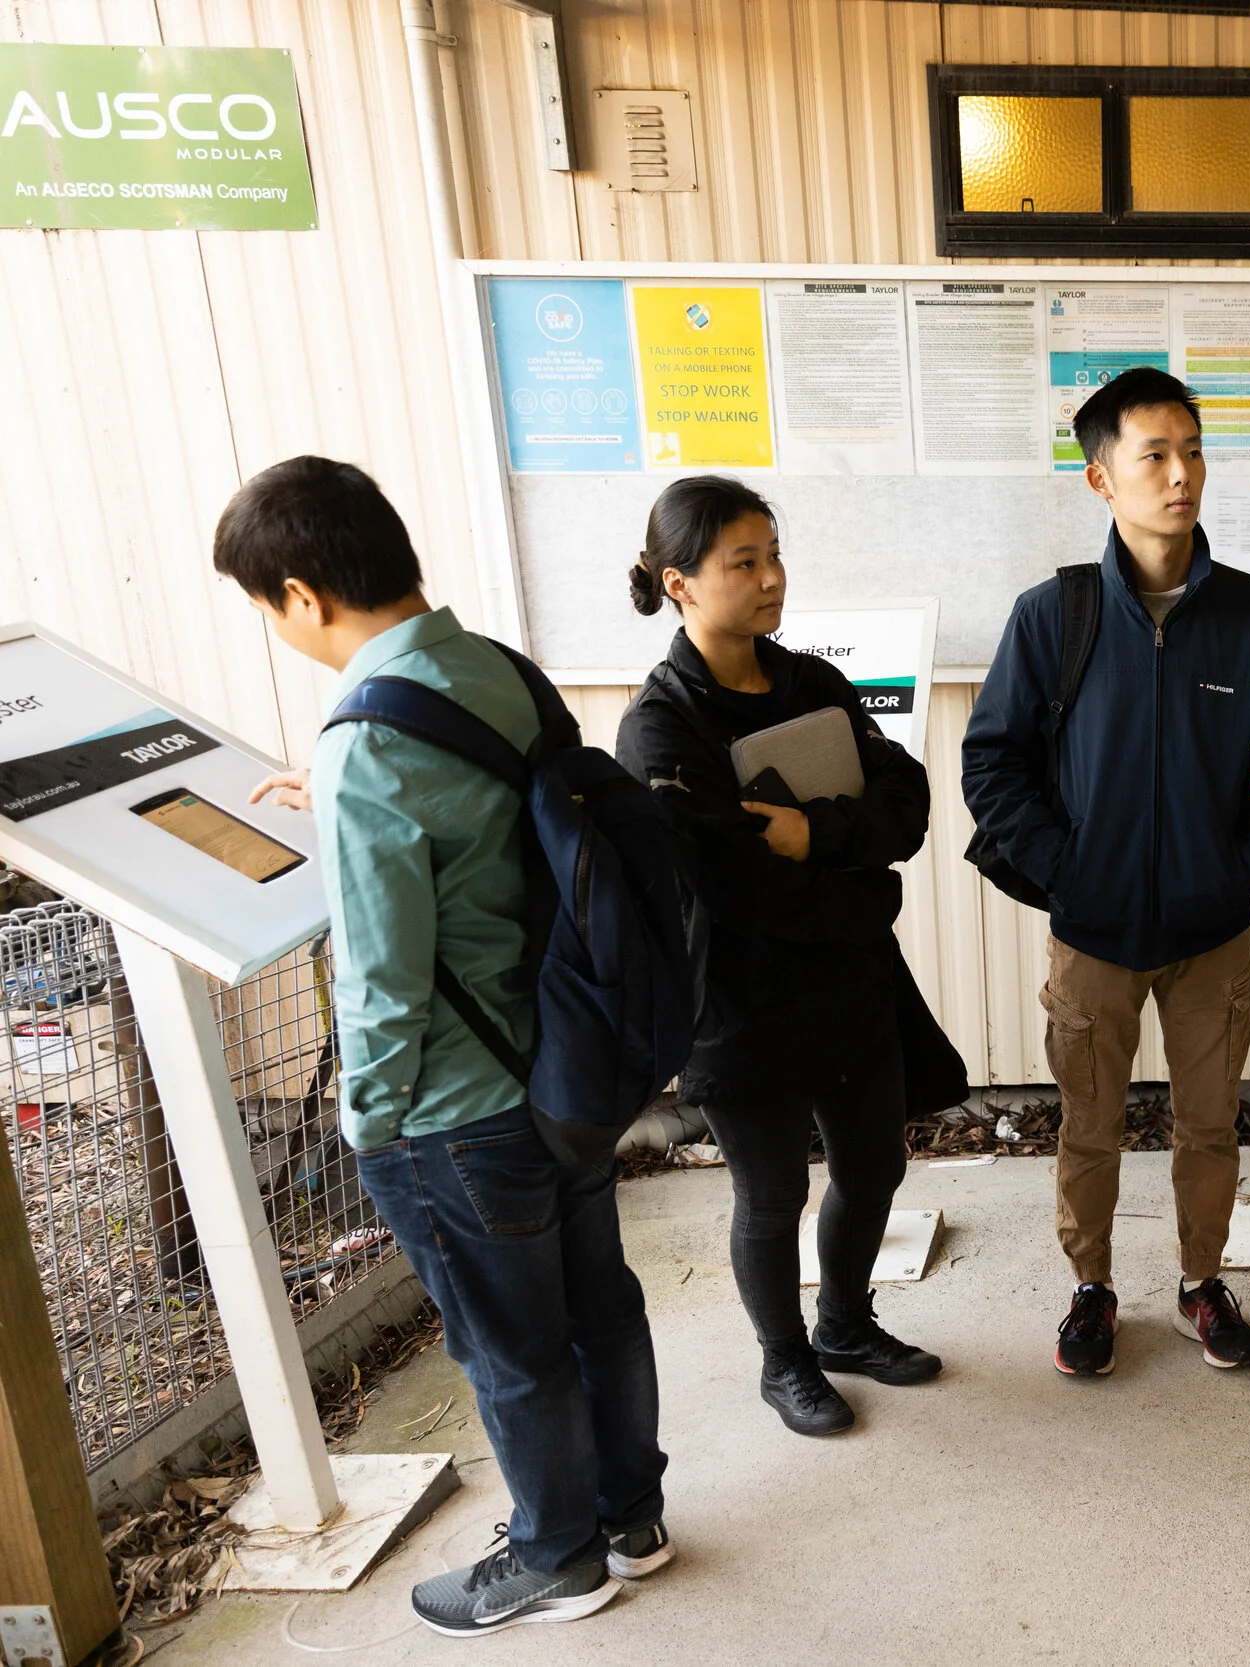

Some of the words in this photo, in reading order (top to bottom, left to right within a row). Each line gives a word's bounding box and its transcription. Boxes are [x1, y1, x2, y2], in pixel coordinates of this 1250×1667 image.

[2, 90, 276, 140] AUSCO
[176, 148, 282, 160] MODULAR
[16, 181, 37, 196] An
[42, 182, 114, 198] ALGECO
[119, 183, 213, 199] SCOTSMAN
[217, 184, 288, 202] Company
[649, 346, 692, 356] TALKING
[695, 347, 709, 356] OR
[713, 347, 755, 357] TEXTING
[654, 363, 670, 372] ON
[673, 364, 681, 372] A
[683, 364, 718, 373] MOBILE
[720, 364, 752, 373] PHONE
[660, 384, 698, 397] STOP
[703, 385, 751, 397] WORK
[656, 410, 690, 422] STOP
[694, 411, 759, 423] WALKING
[789, 645, 856, 657] ister
[1206, 683, 1234, 694] HILFIGER
[0, 695, 44, 719] ster
[860, 696, 900, 708] LOR
[120, 733, 198, 764] TAYLOR
[3, 780, 81, 810] taylorau.com.au
